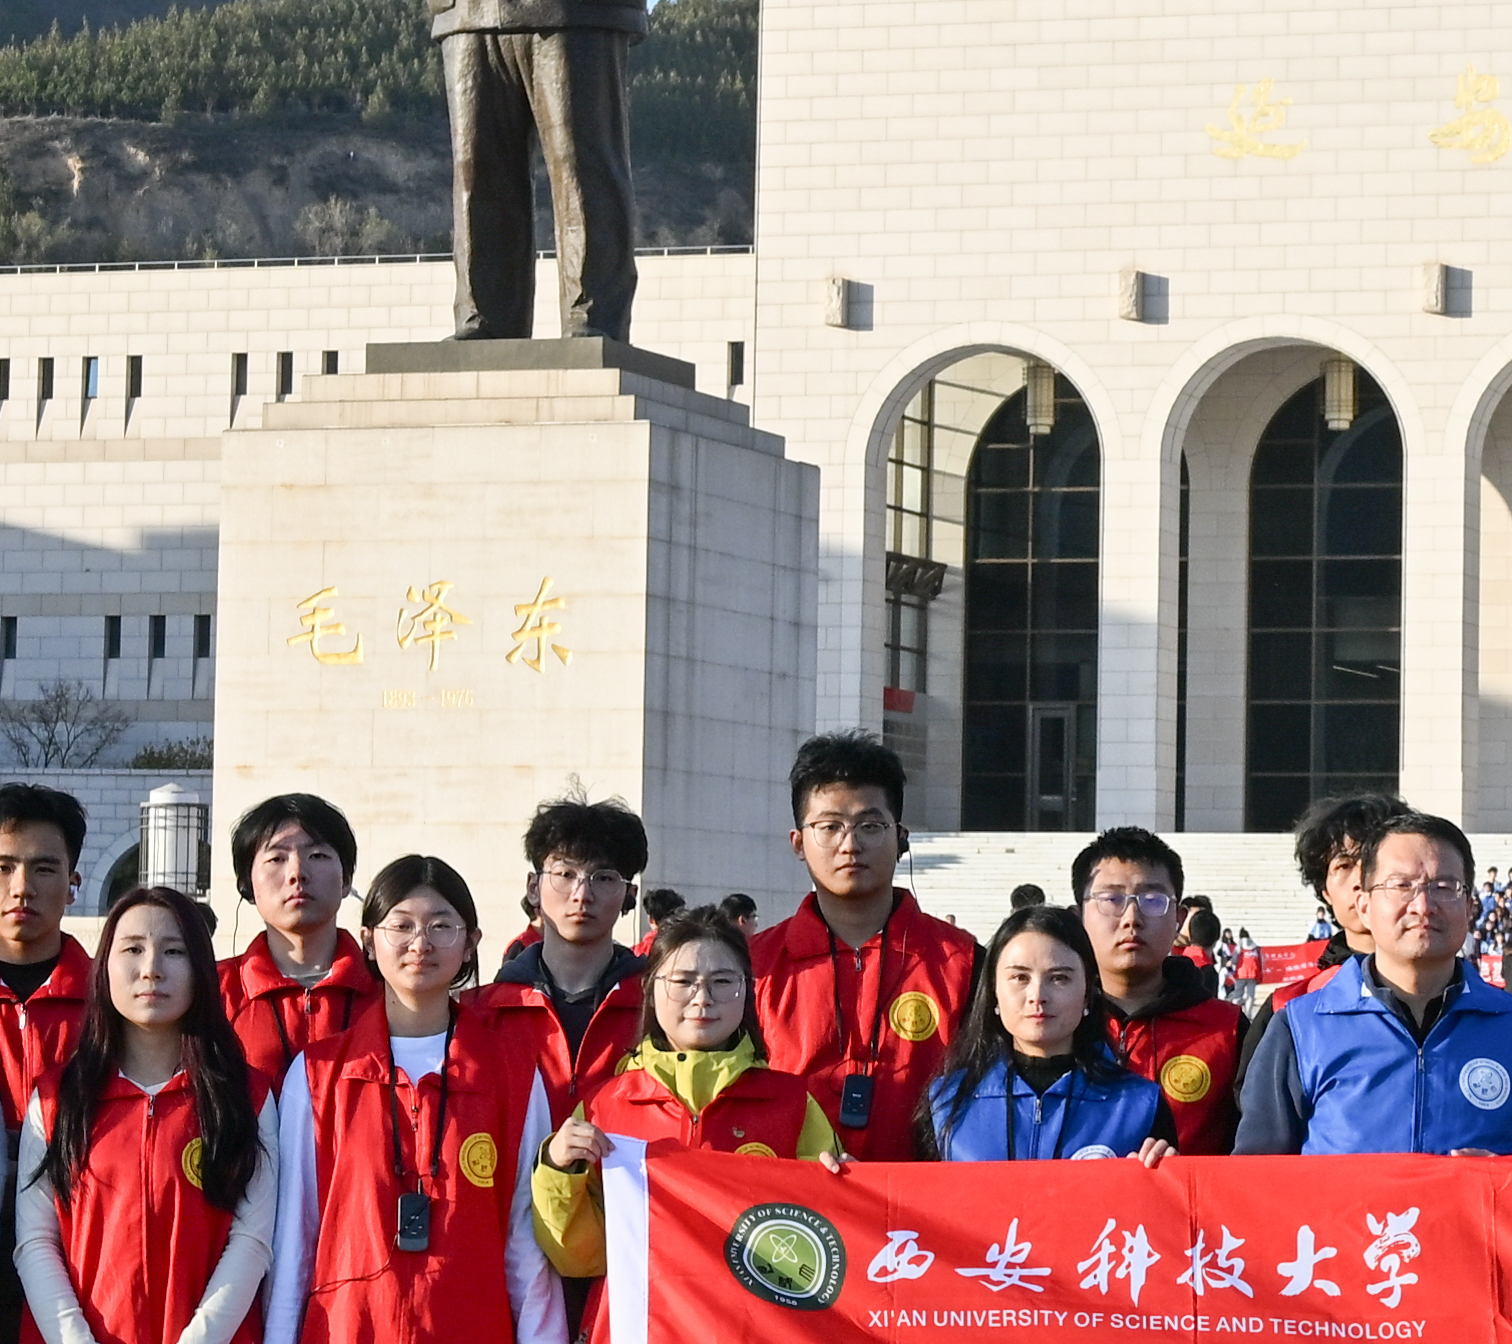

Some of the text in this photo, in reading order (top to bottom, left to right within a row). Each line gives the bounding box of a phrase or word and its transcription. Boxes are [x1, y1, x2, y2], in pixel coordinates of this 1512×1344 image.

[287, 576, 573, 674] 毛泽东
[866, 1206, 1421, 1308] 西安科技大学
[868, 1309, 1426, 1340] XI'AN UNIVERSITY OF SCIENCE AND TECHNOLOGY
